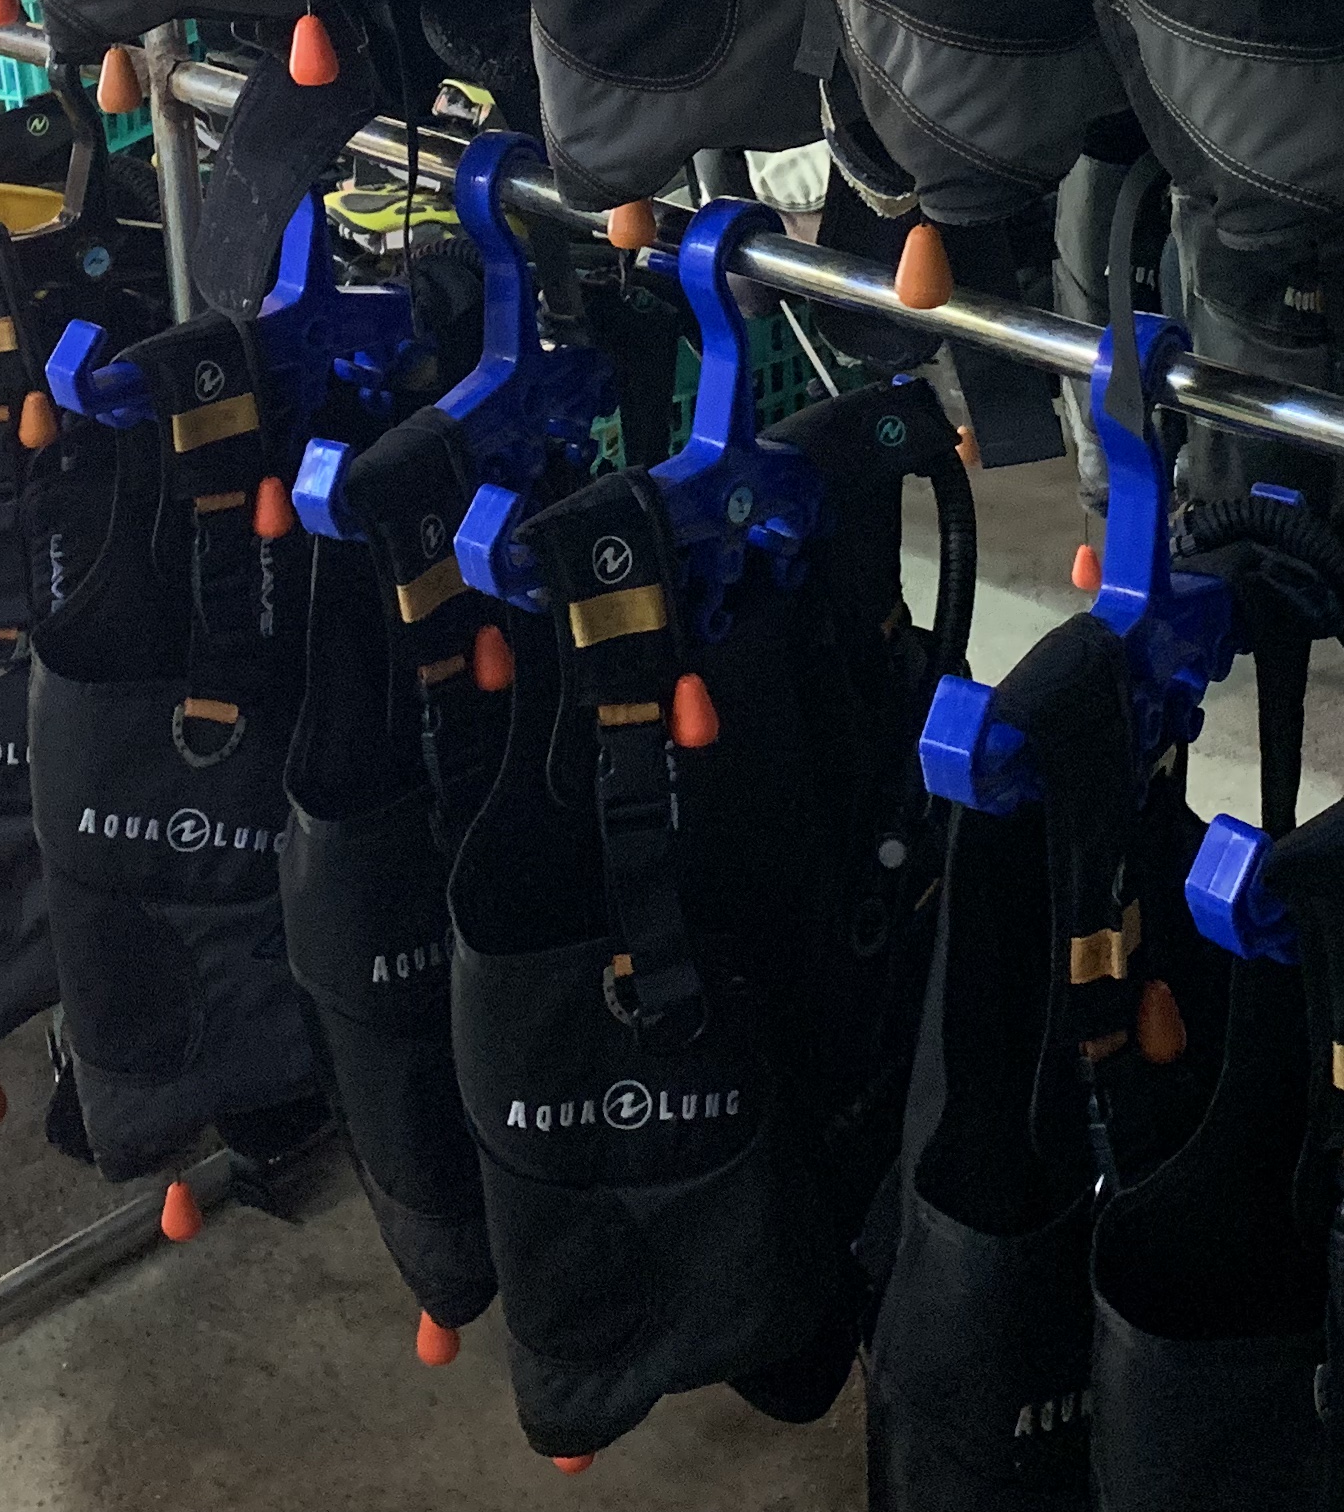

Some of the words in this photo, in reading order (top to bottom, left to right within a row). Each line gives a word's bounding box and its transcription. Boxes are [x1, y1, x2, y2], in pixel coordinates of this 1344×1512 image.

[79, 808, 159, 841] AQUA
[507, 1100, 596, 1132] AQUA
[659, 1090, 739, 1120] LUNG
